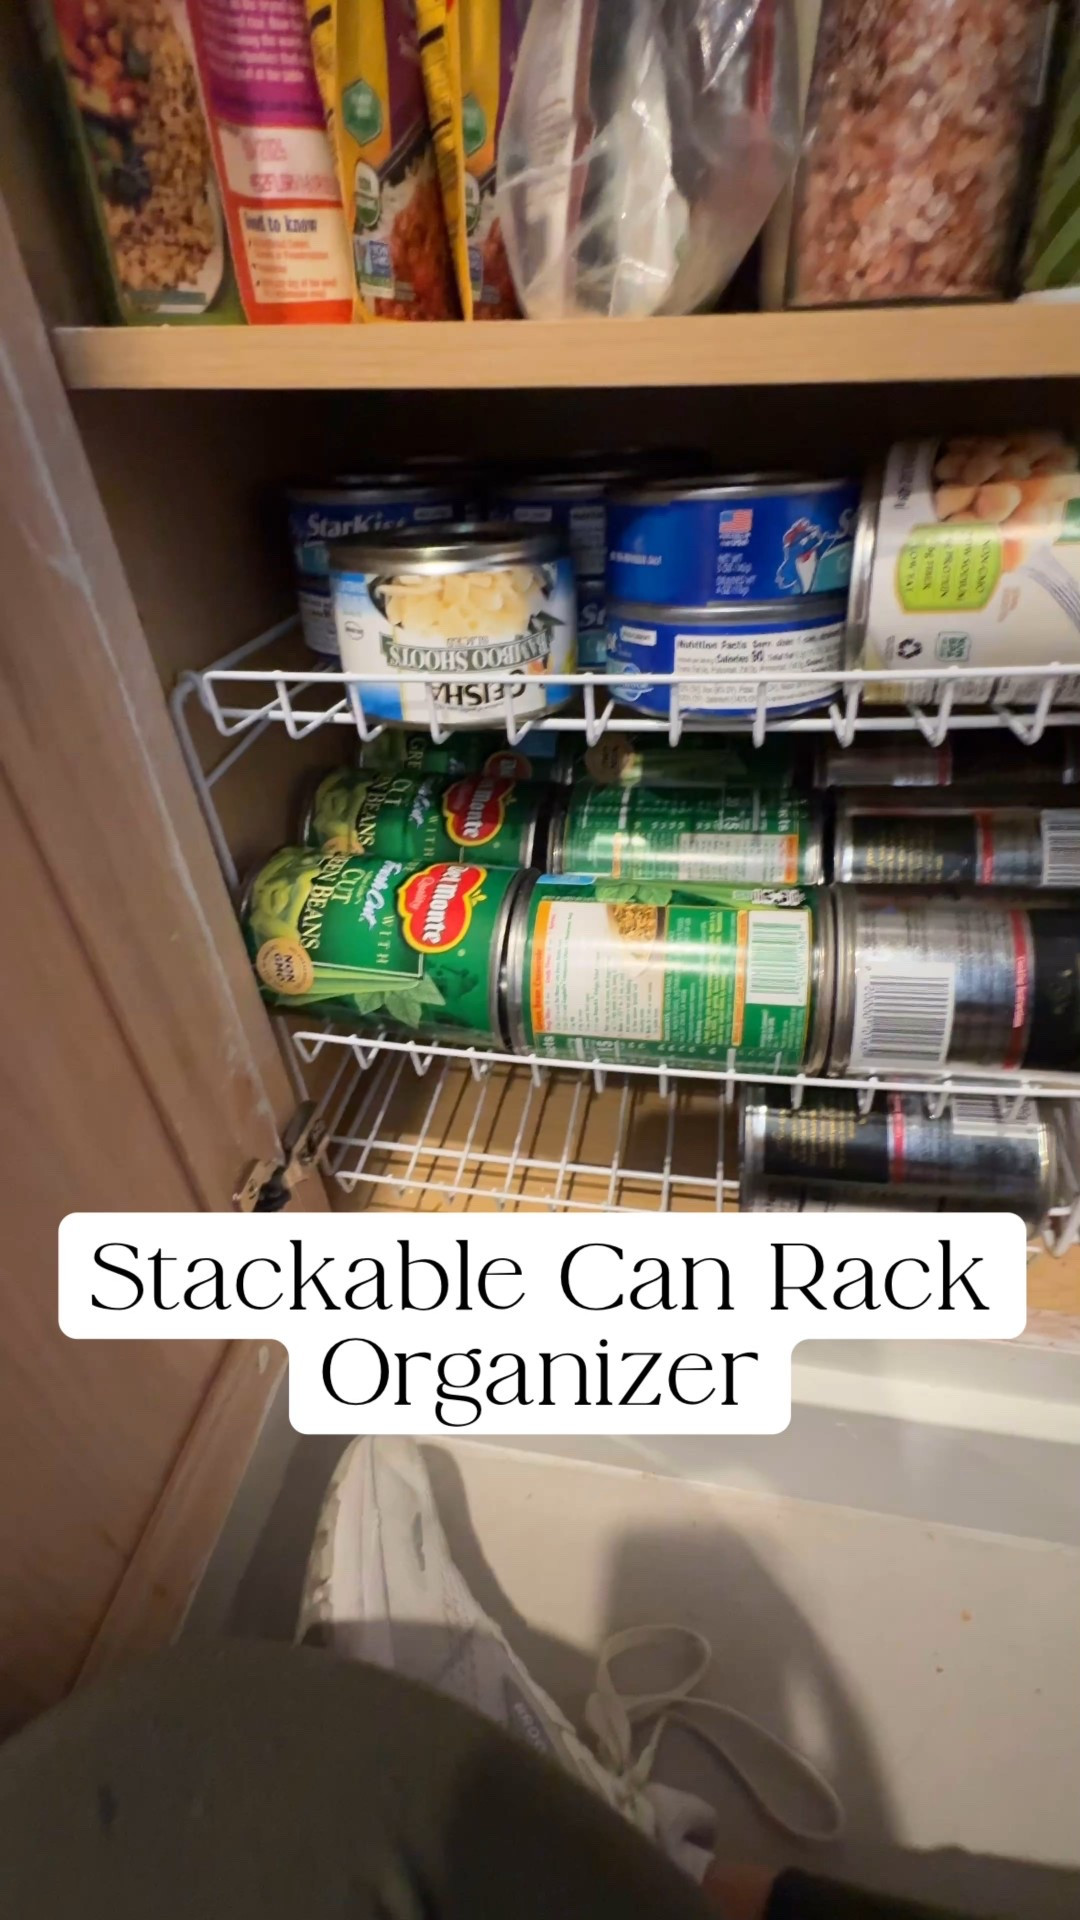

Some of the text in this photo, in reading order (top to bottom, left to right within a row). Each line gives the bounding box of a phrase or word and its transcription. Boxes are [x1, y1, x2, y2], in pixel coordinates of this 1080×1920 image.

[388, 644, 468, 673] SHOOTS
[470, 635, 548, 671] BAMBOO
[357, 790, 386, 846] BEANS
[423, 814, 440, 858] WITH
[331, 868, 366, 905] CUT
[299, 886, 337, 950] BEANS
[423, 882, 457, 945] Monte
[376, 915, 395, 965] WITH
[274, 951, 286, 983] GMO
[284, 953, 295, 984] NON
